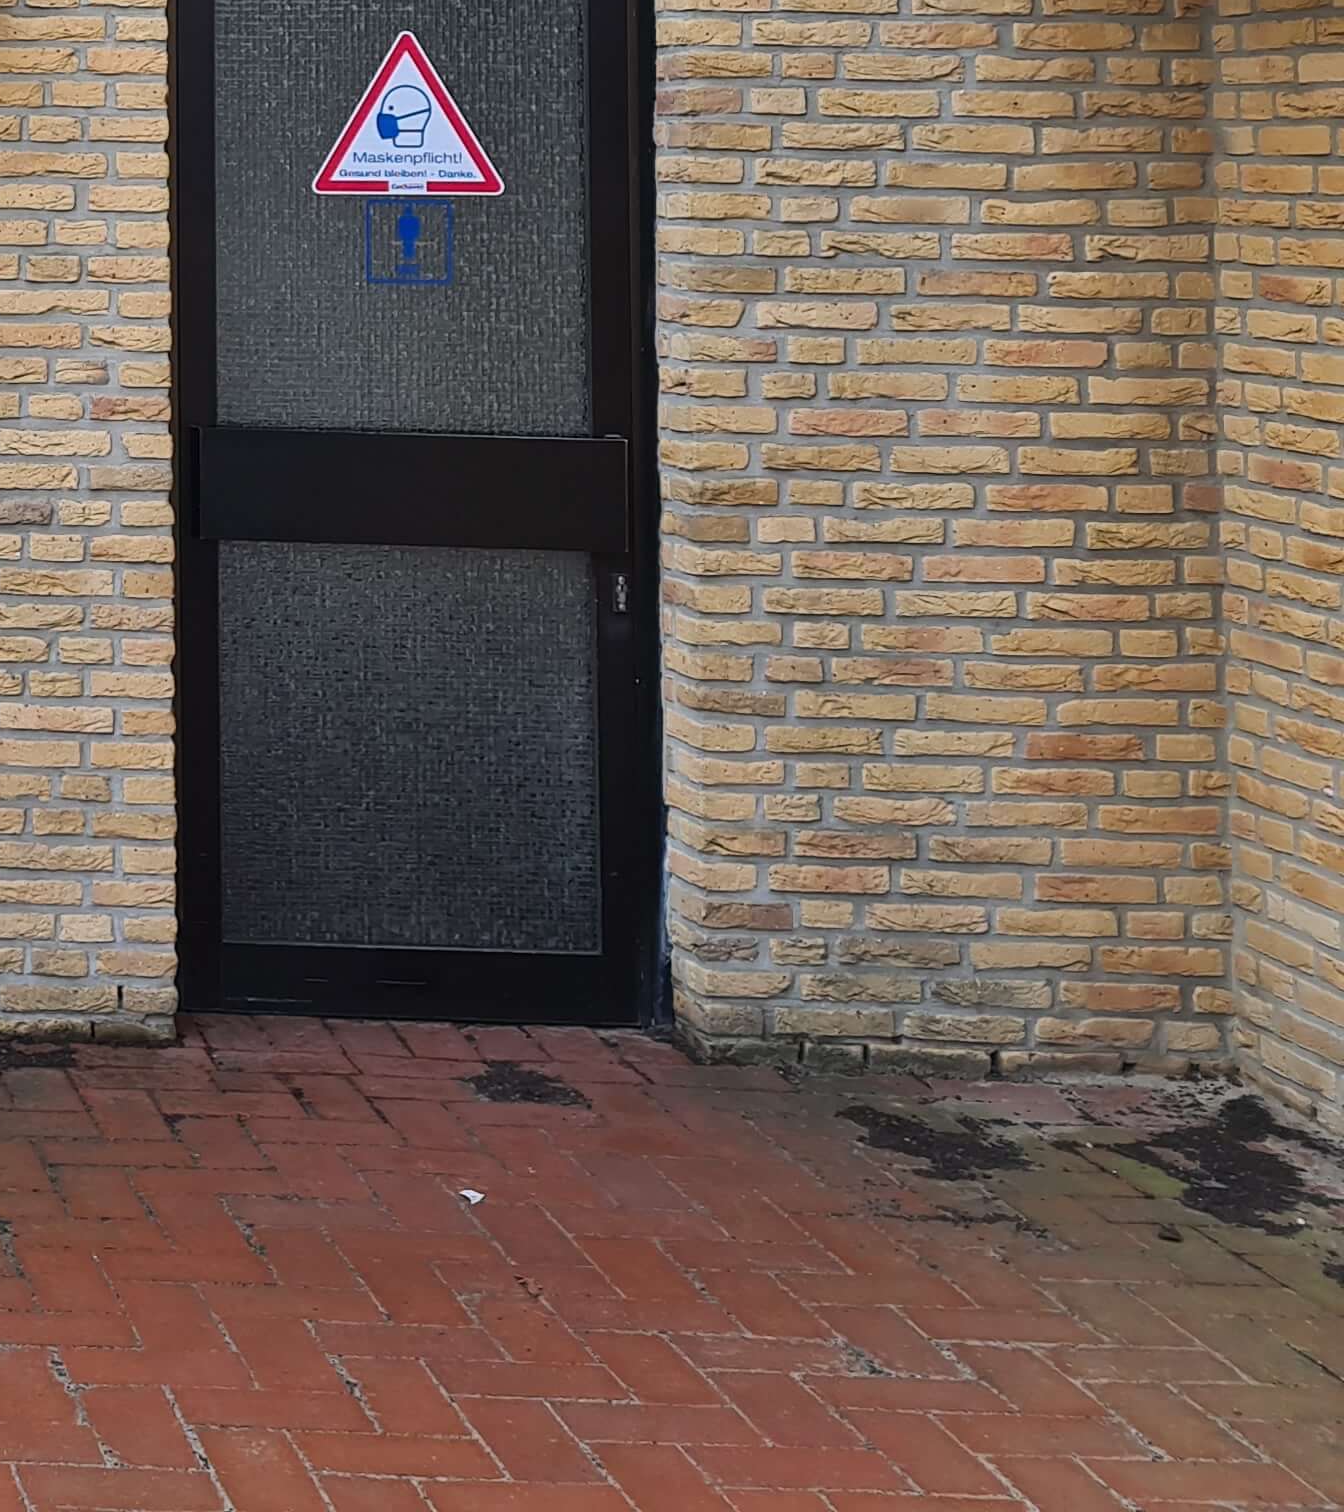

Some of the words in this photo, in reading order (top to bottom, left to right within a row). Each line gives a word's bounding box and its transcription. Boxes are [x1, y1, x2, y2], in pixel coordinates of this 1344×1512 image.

[353, 152, 462, 165] Maskenpflicht!
[339, 169, 381, 177] Gesund
[384, 169, 427, 177] bleiben!
